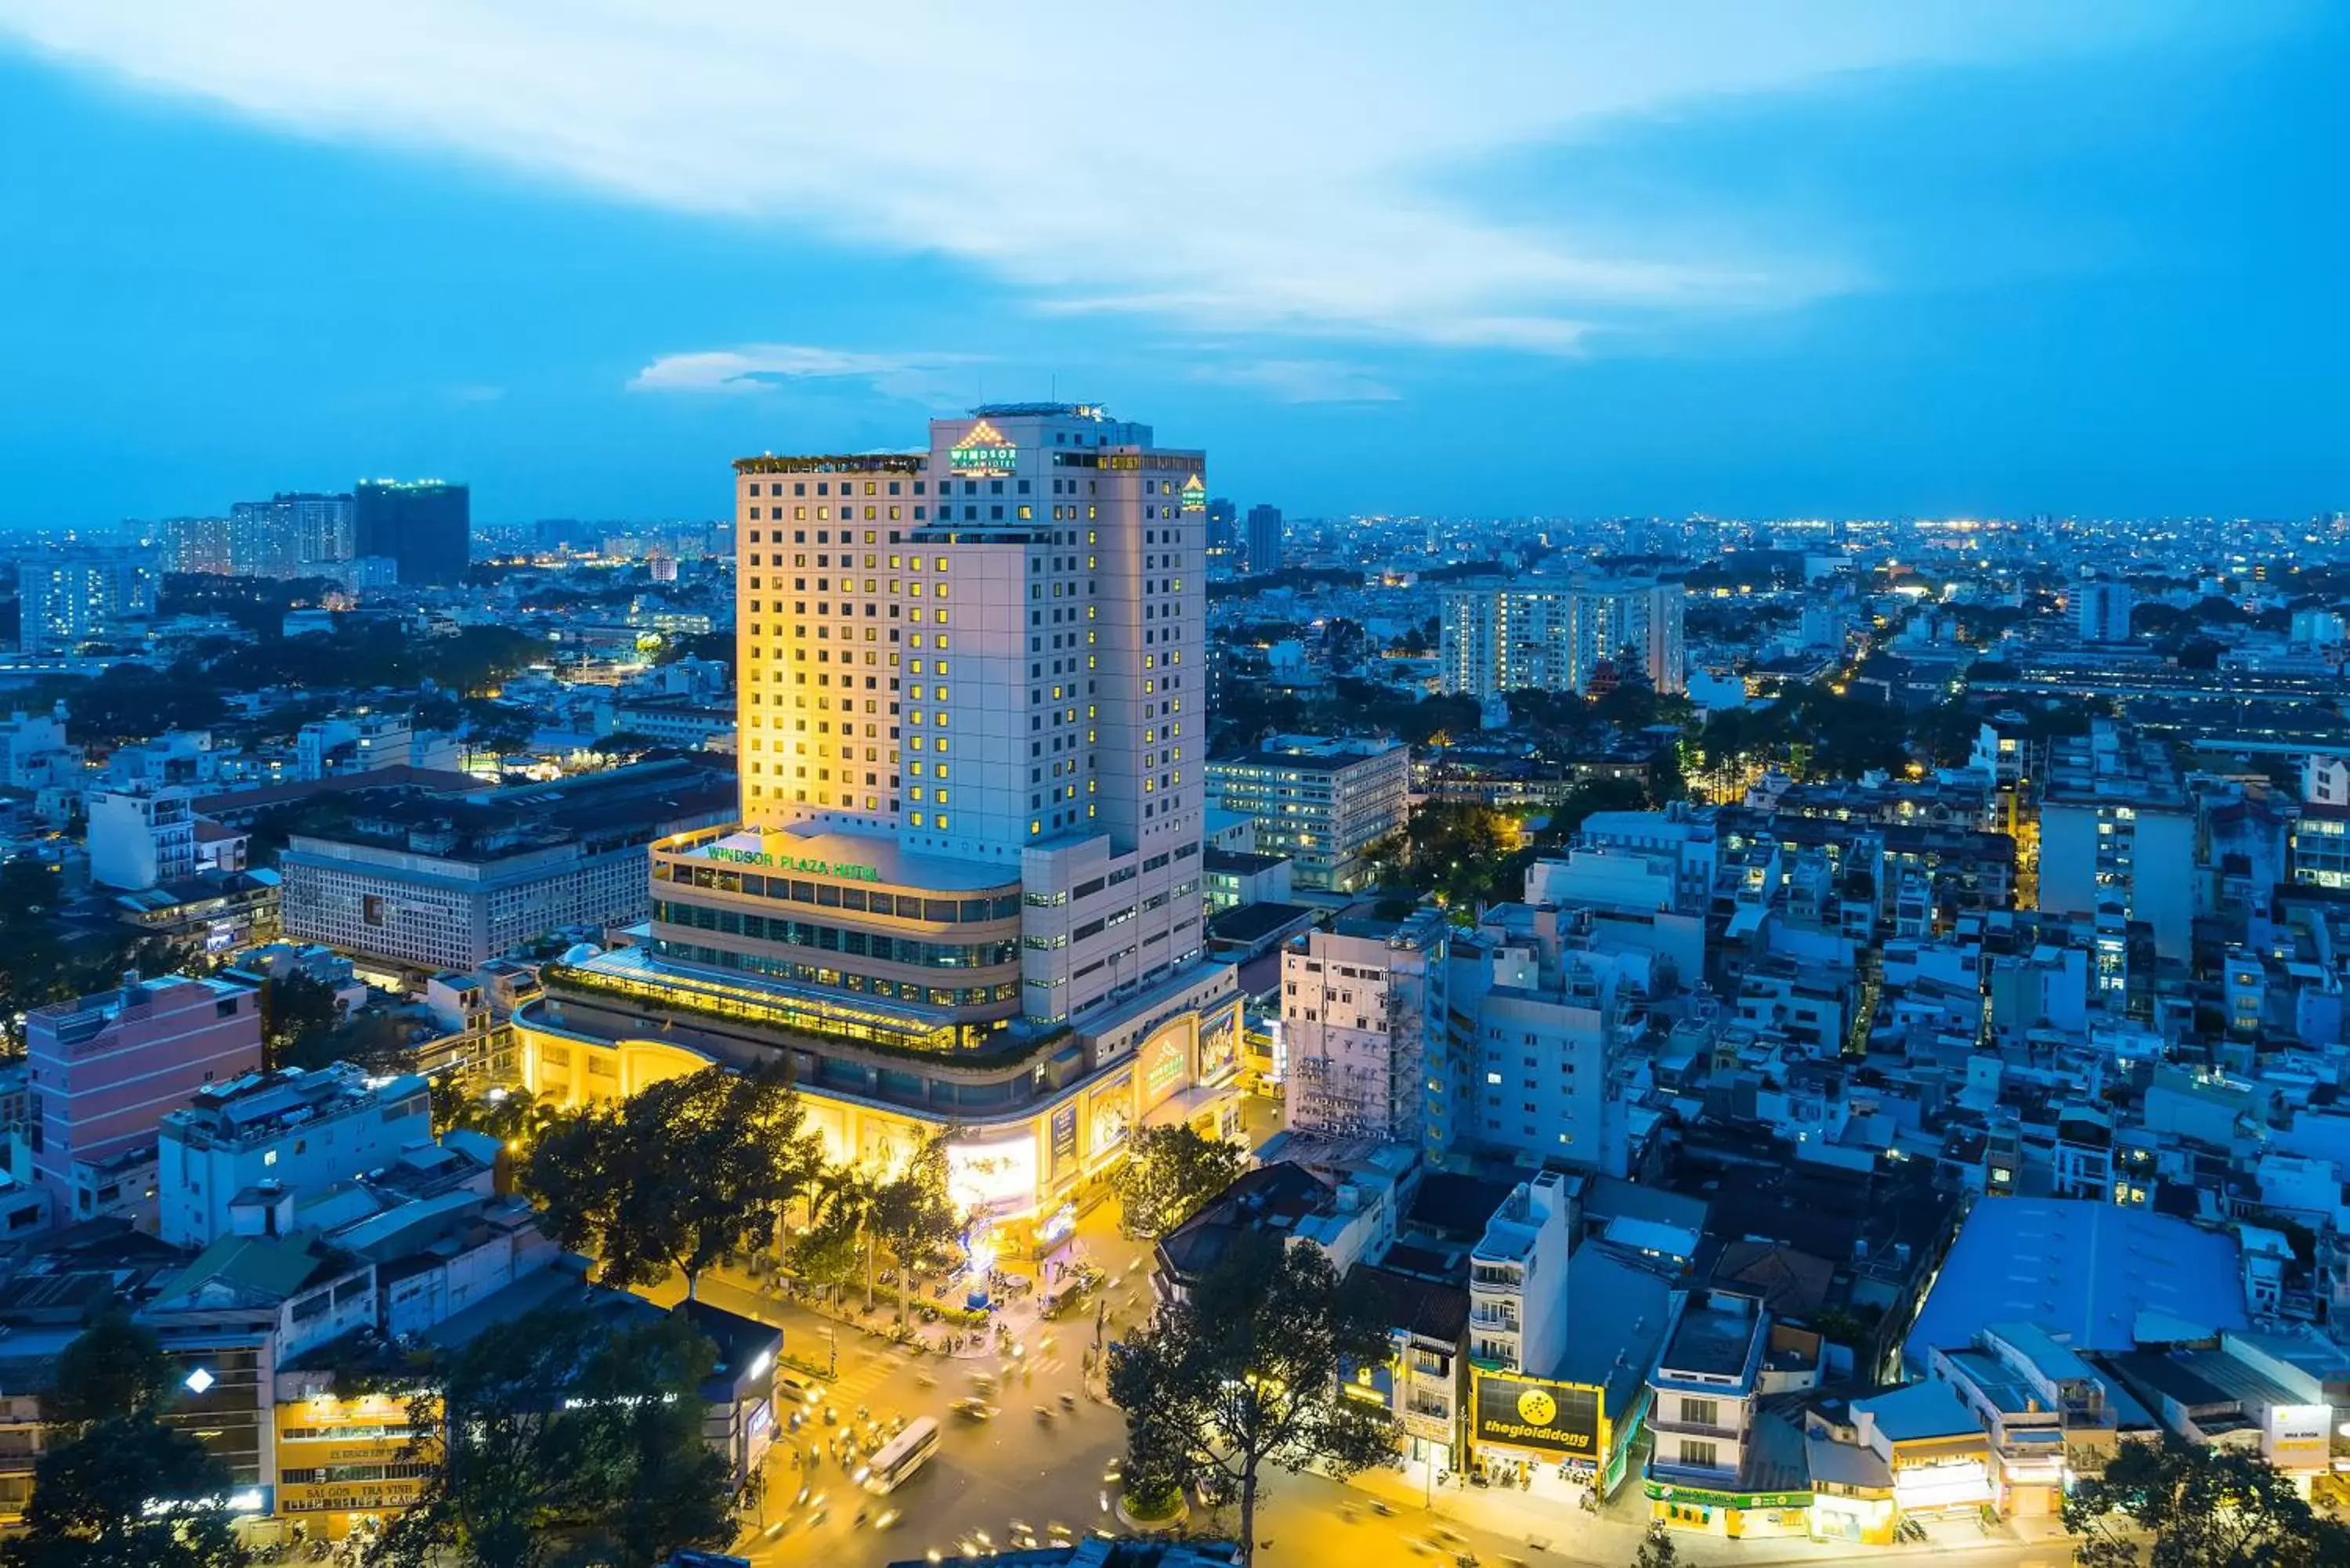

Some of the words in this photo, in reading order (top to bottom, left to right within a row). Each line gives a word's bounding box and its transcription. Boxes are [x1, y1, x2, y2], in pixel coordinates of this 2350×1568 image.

[707, 845, 773, 867] WINDSOR
[779, 855, 828, 875] PLAZA
[833, 862, 878, 883] HOTEL
[1484, 1419, 1589, 1448] thegioididong
